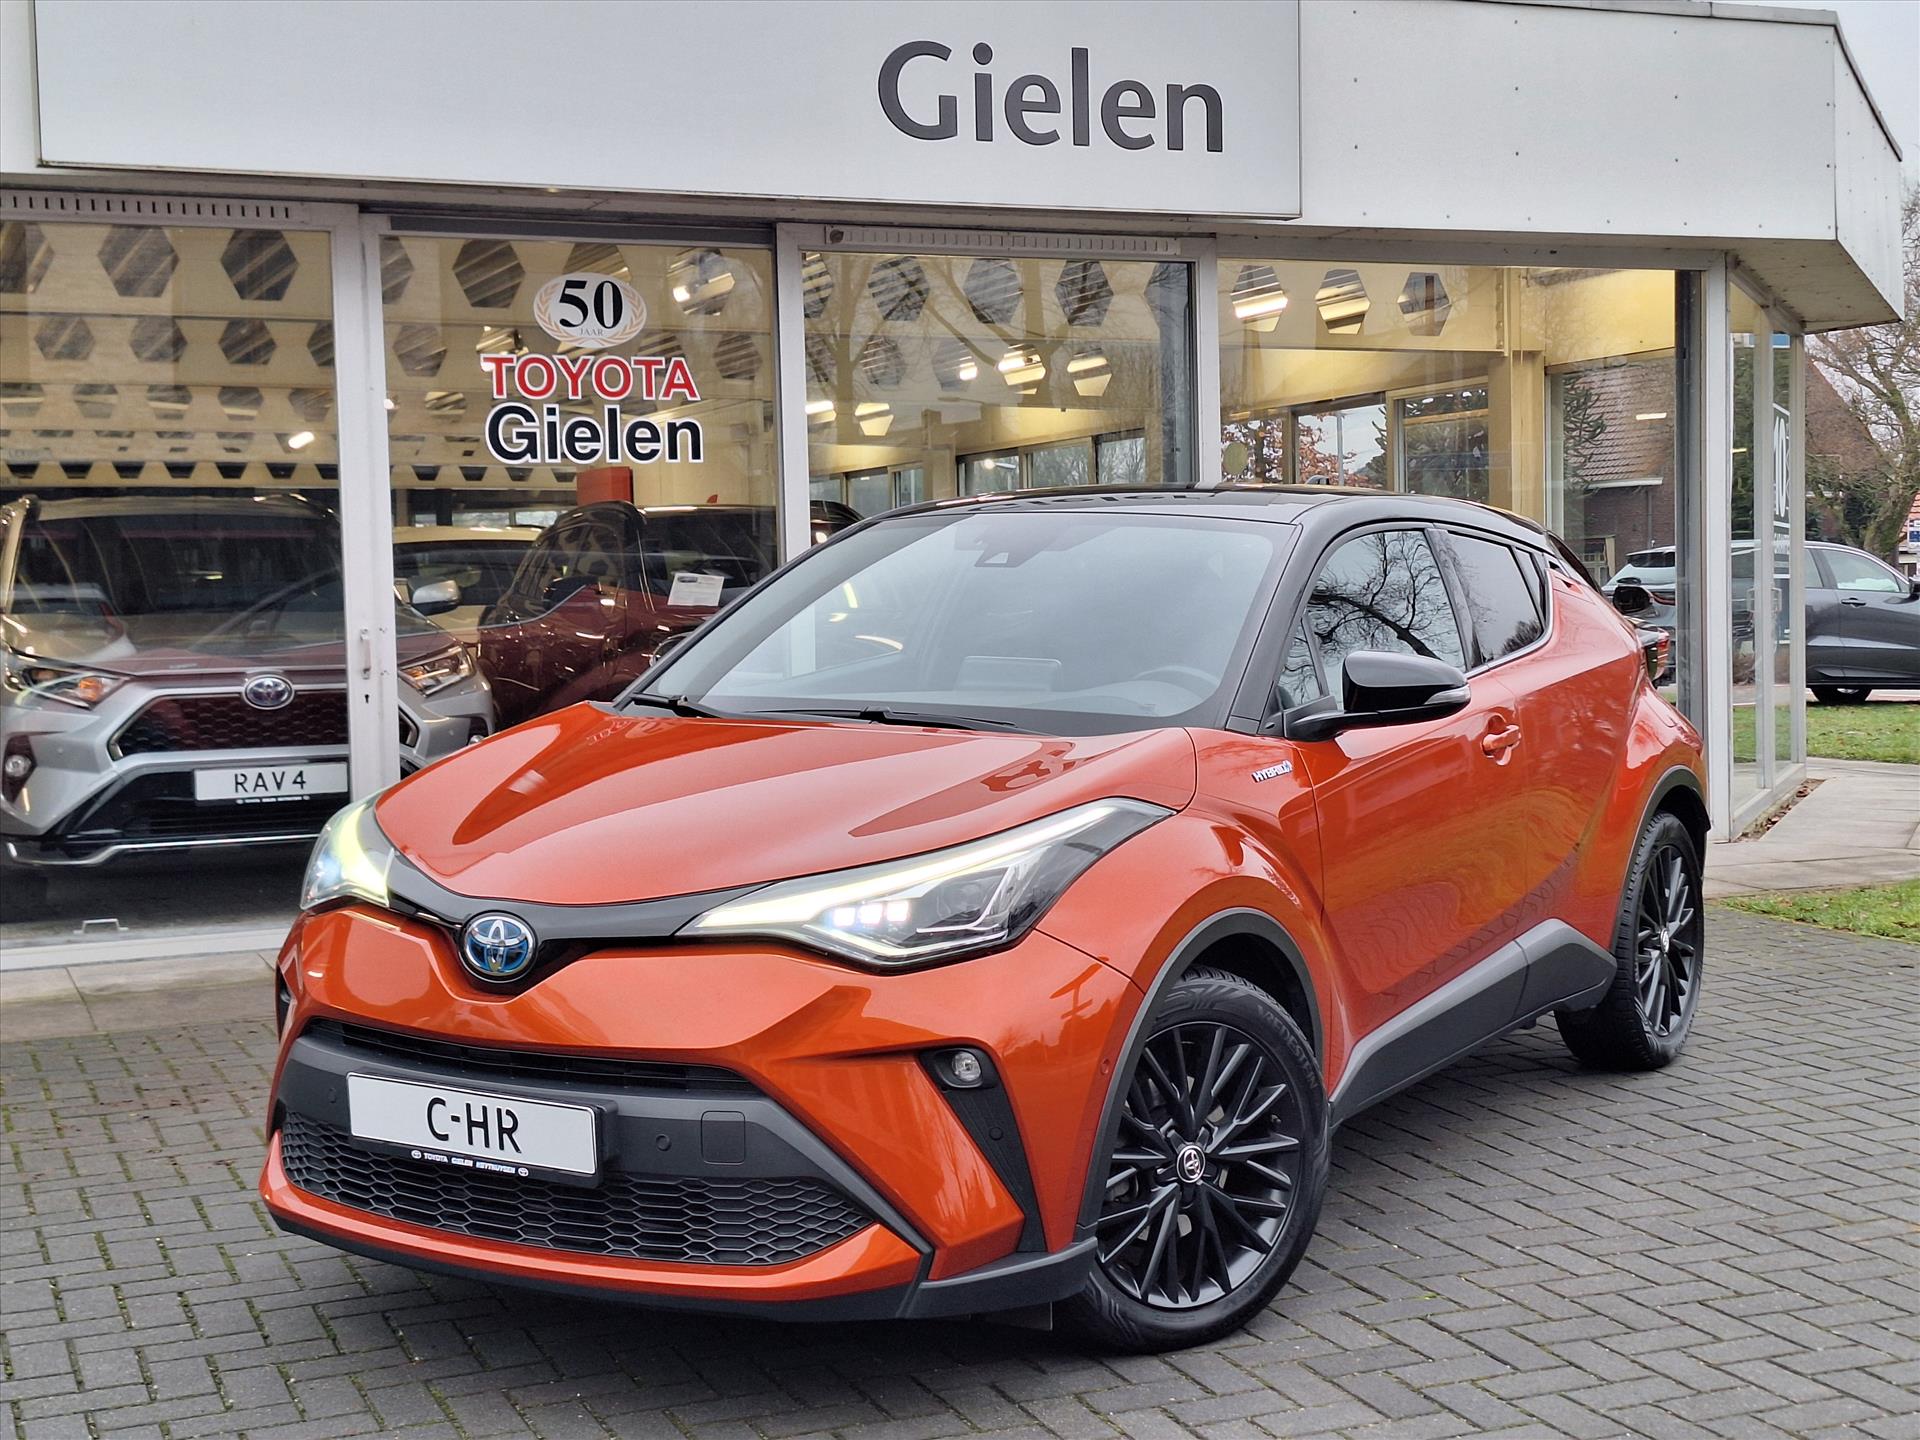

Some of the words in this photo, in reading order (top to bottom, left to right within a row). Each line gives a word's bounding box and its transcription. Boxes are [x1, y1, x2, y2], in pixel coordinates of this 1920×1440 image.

[878, 40, 1223, 153] Gielen
[559, 279, 623, 329] 50
[579, 328, 605, 337] JAAR
[481, 355, 700, 400] TOYOTA
[486, 403, 703, 463] Gielen
[1251, 761, 1290, 783] HYBRID
[427, 1097, 522, 1154] C-HR
[423, 1152, 449, 1163] TOYOTA
